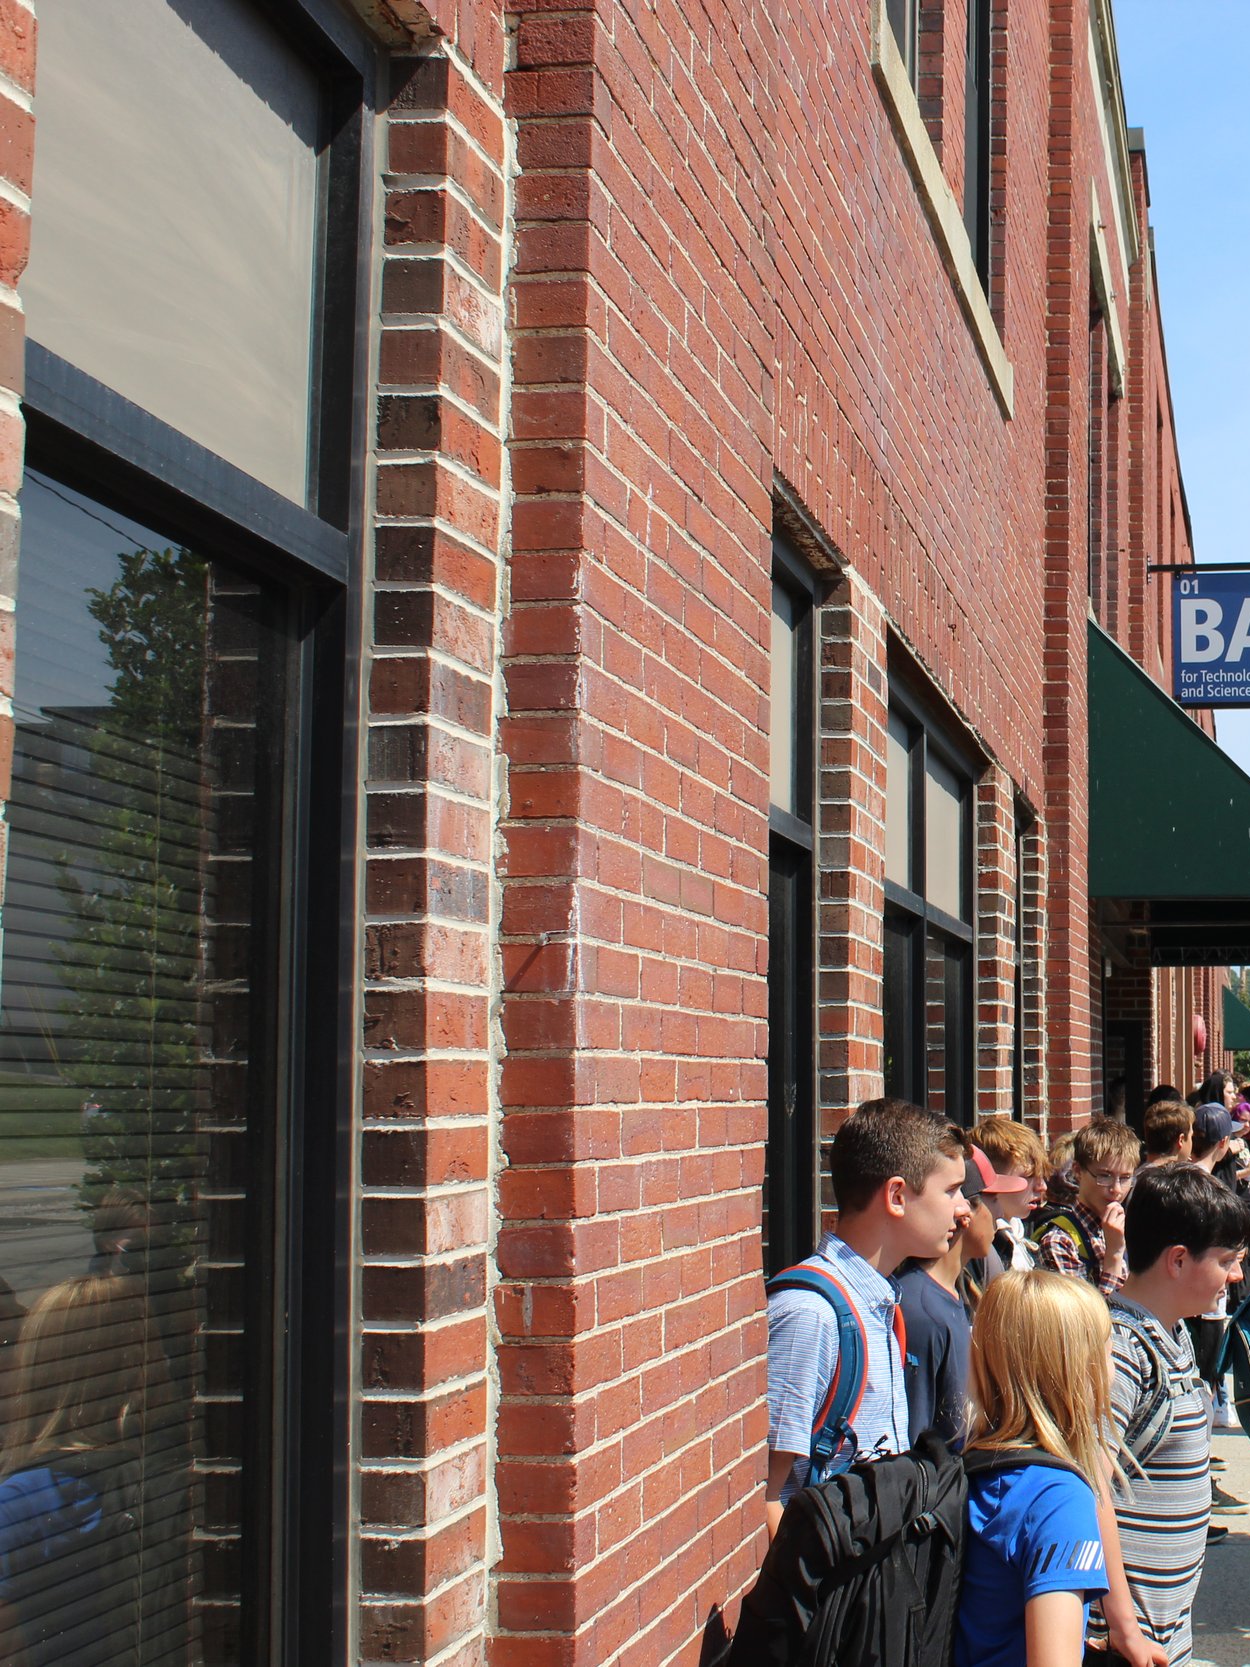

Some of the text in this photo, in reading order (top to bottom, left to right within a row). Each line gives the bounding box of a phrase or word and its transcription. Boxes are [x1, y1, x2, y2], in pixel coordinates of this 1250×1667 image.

[1180, 579, 1199, 595] 01
[1180, 669, 1199, 683] for
[1181, 684, 1204, 698] and
